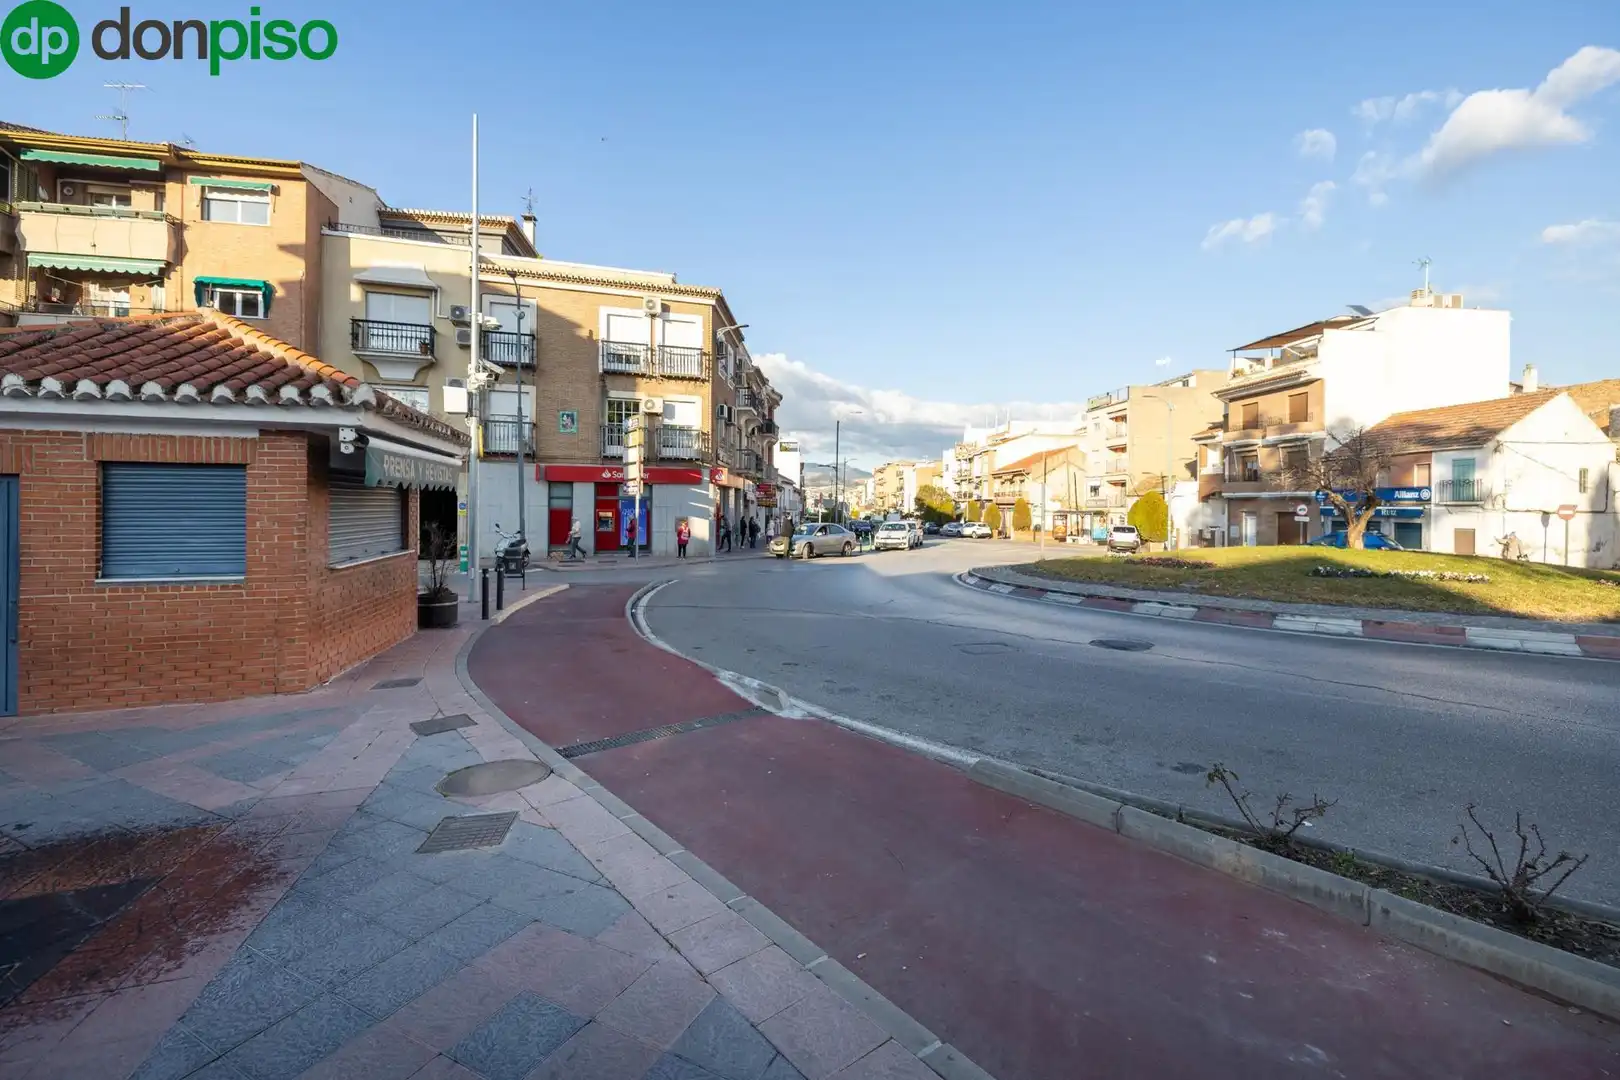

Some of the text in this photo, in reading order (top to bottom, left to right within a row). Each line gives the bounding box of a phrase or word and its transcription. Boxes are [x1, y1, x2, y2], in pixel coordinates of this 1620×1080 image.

[383, 454, 453, 482] PRENSA Y REVISTAS
[1394, 490, 1419, 499] Allianz
